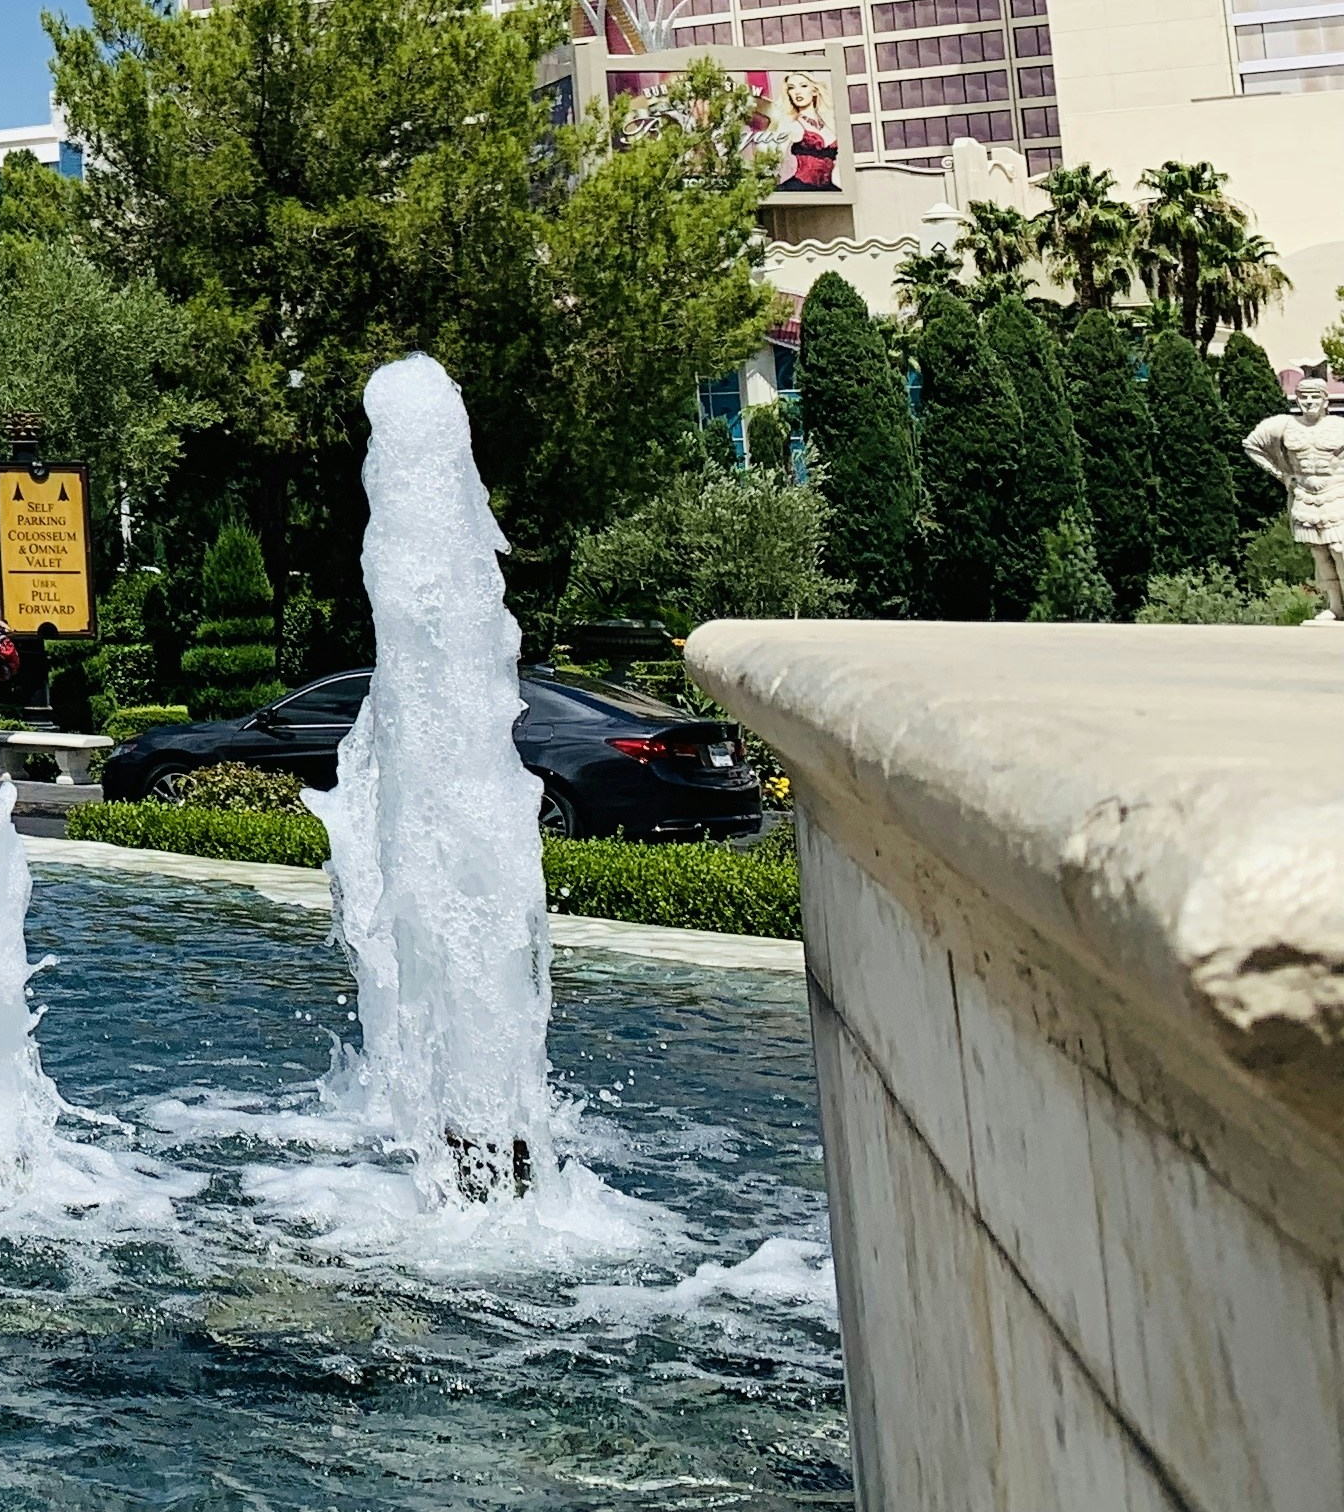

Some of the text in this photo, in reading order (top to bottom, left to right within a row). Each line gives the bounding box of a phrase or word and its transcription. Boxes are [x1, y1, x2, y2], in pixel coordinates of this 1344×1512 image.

[27, 501, 54, 512] SELF
[17, 515, 66, 526] PARKING
[7, 529, 77, 541] COLOSSEUM
[18, 543, 68, 554] & OMNIA
[25, 556, 62, 568] VALET
[31, 590, 61, 602] PULL
[18, 603, 76, 615] FORWARD
